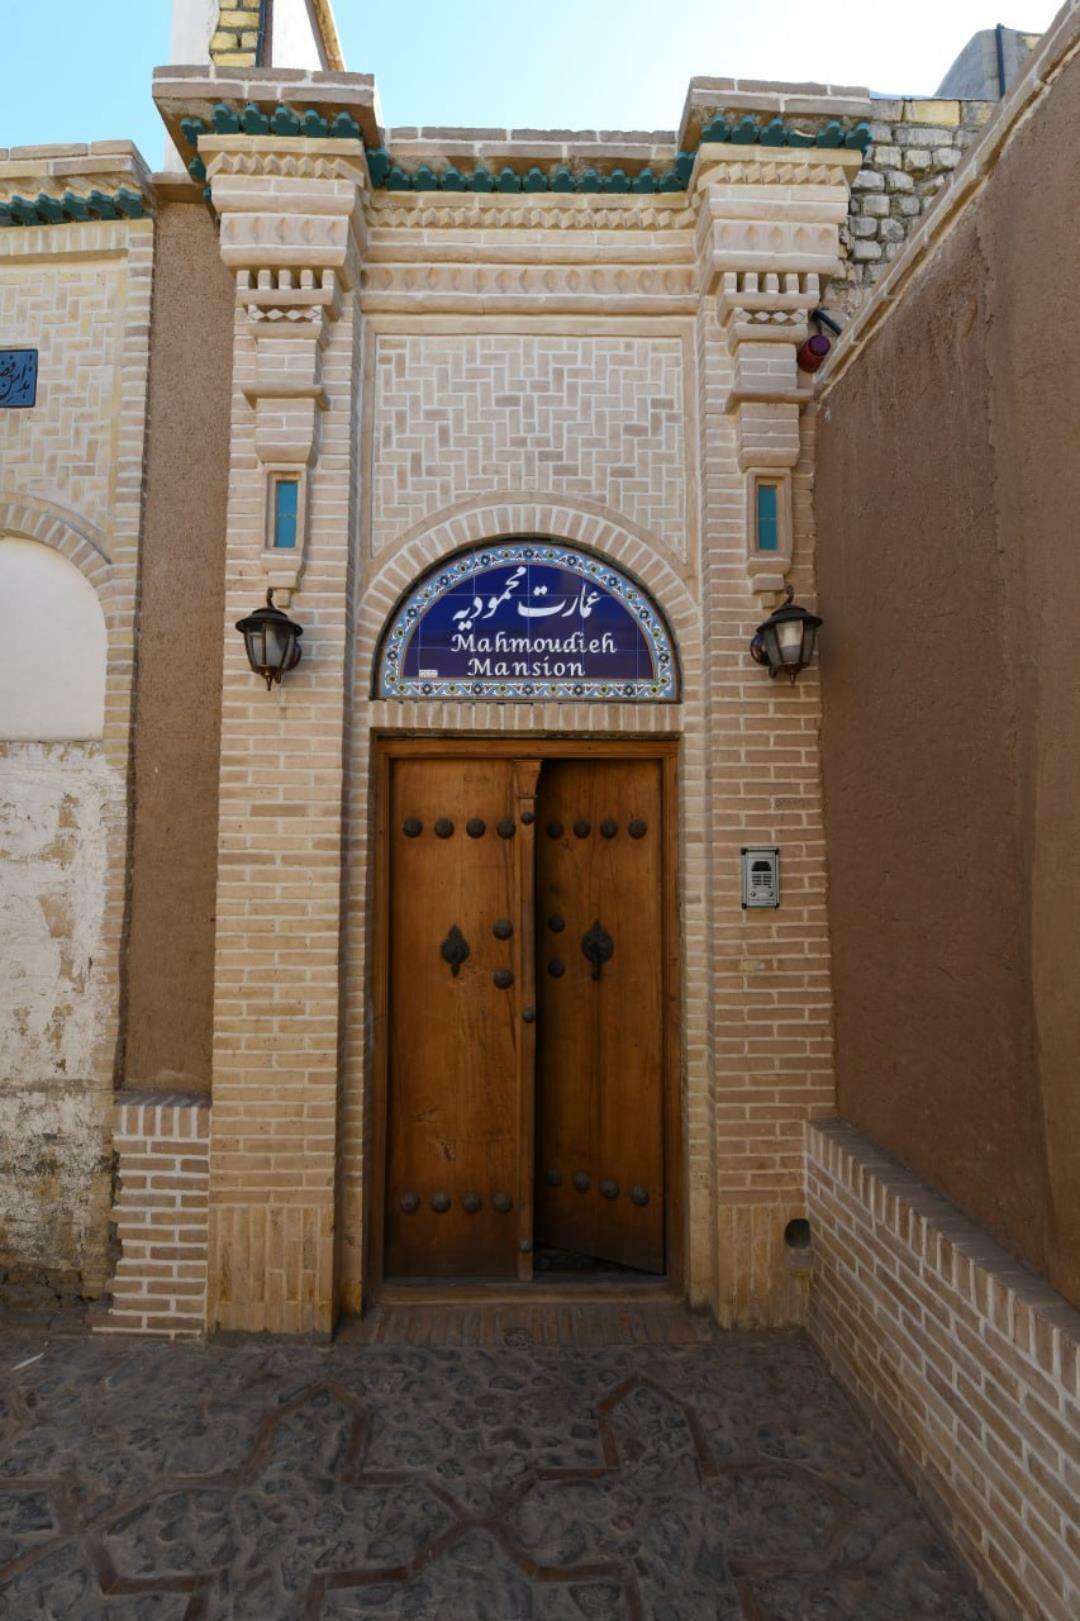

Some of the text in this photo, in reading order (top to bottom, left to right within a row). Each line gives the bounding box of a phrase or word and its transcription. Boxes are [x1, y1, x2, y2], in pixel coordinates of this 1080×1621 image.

[517, 583, 601, 619] عمارت
[451, 631, 617, 653] Mahmoudieh
[467, 655, 586, 677] Mansion
